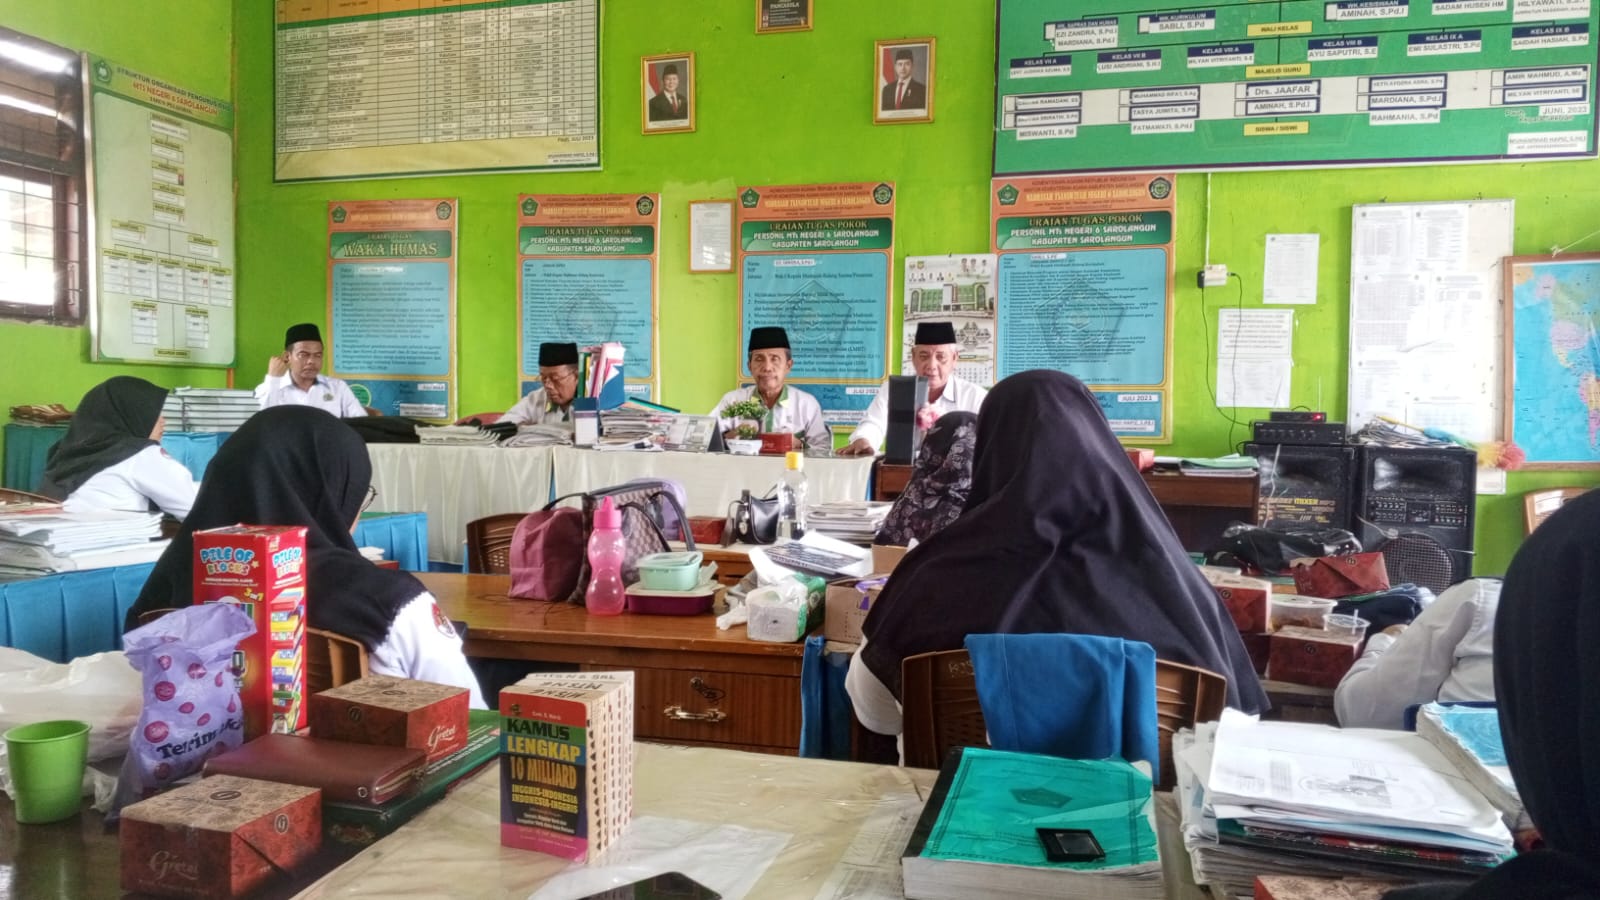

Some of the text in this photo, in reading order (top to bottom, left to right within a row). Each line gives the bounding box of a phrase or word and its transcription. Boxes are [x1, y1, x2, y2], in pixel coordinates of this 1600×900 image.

[1435, 3, 1462, 11] SADAM
[1340, 8, 1378, 18] AMINAH,
[1158, 20, 1206, 30] SABLI, S.Pd
[1261, 25, 1276, 33] WALI
[1068, 28, 1098, 37] ZANDRA,
[1058, 38, 1096, 47] MARDIANA,
[1322, 40, 1344, 48] KELAS
[1202, 47, 1224, 55] KELAS
[1308, 50, 1326, 58] AYU
[1326, 48, 1362, 57] SAPUTRI,
[1024, 58, 1043, 66] KELAS
[1283, 64, 1302, 73] GURU
[1527, 71, 1563, 80] MAHMUD,
[1254, 85, 1311, 96] Drs. JAAFAR
[1371, 95, 1417, 104] MARDIANA,
[1254, 102, 1287, 111] AMINAH,
[1371, 112, 1418, 122] RAHMANIA,
[770, 220, 868, 230] URAIAN TUGAS POKOK
[1029, 214, 1143, 227] URAIAN TUGAS POKOK
[544, 227, 633, 236] URAIAN TUGAS POKOK
[754, 232, 785, 240] PERSONIL
[833, 230, 880, 238] SAROLANGUN
[1010, 228, 1046, 237] PERSONIL
[1064, 226, 1093, 235] NEGERI
[1102, 224, 1156, 234] SAROLANGUN
[772, 240, 859, 249] KABUPATEN SAROLANGUN
[1032, 234, 1133, 246] KABUPATEN SAROLANGUN
[344, 242, 438, 257] WAKA HUMAS
[200, 546, 255, 564] PILE OF
[206, 562, 250, 576] BLOCKS
[506, 719, 570, 742] KAMUS
[507, 736, 581, 763] LENGKAP
[511, 756, 578, 790] 10 MILLIARD
[512, 784, 578, 804] INGGRIS-INDONESIA
[512, 794, 579, 814] INDONESIA-INGGRIS
